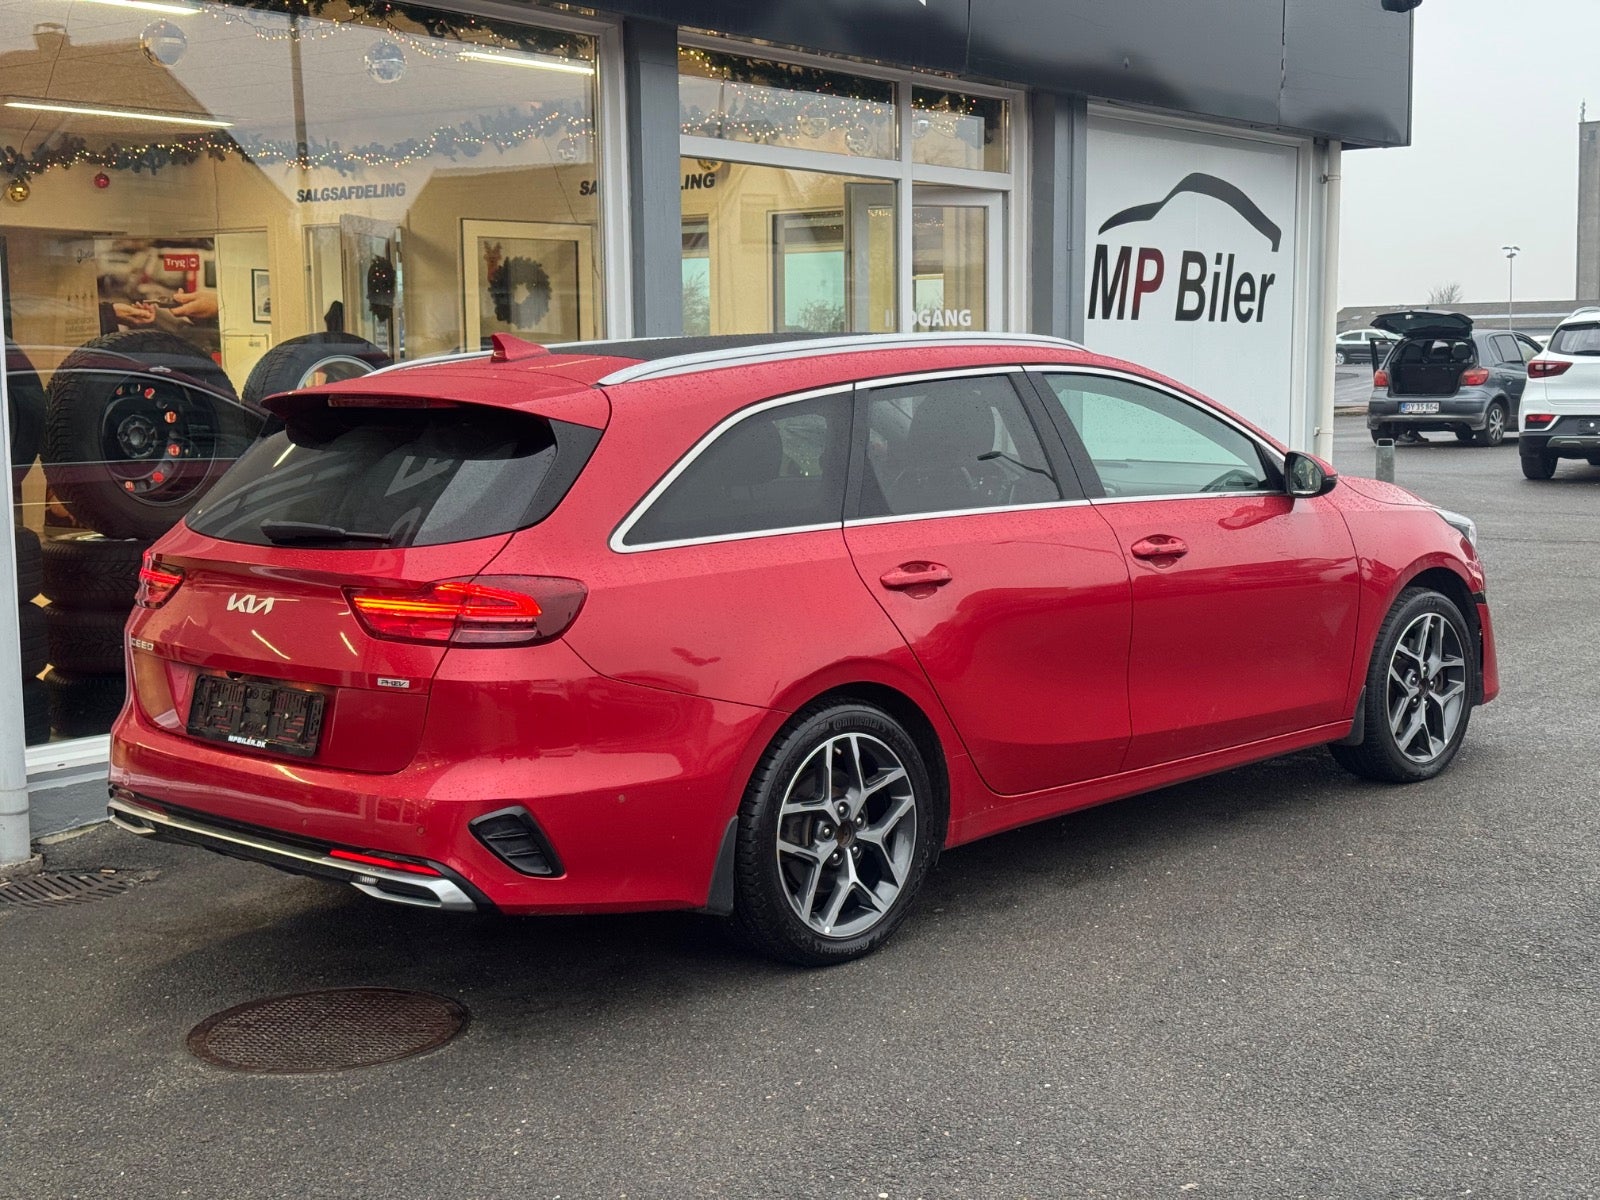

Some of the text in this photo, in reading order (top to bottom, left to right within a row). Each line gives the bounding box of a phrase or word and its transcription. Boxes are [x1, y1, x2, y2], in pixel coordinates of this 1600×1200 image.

[296, 182, 406, 203] SALGSAFDELING
[166, 258, 186, 269] Tryg
[1088, 244, 1276, 324] MP Biler
[885, 309, 972, 327] IGANG
[226, 592, 275, 616] KIA
